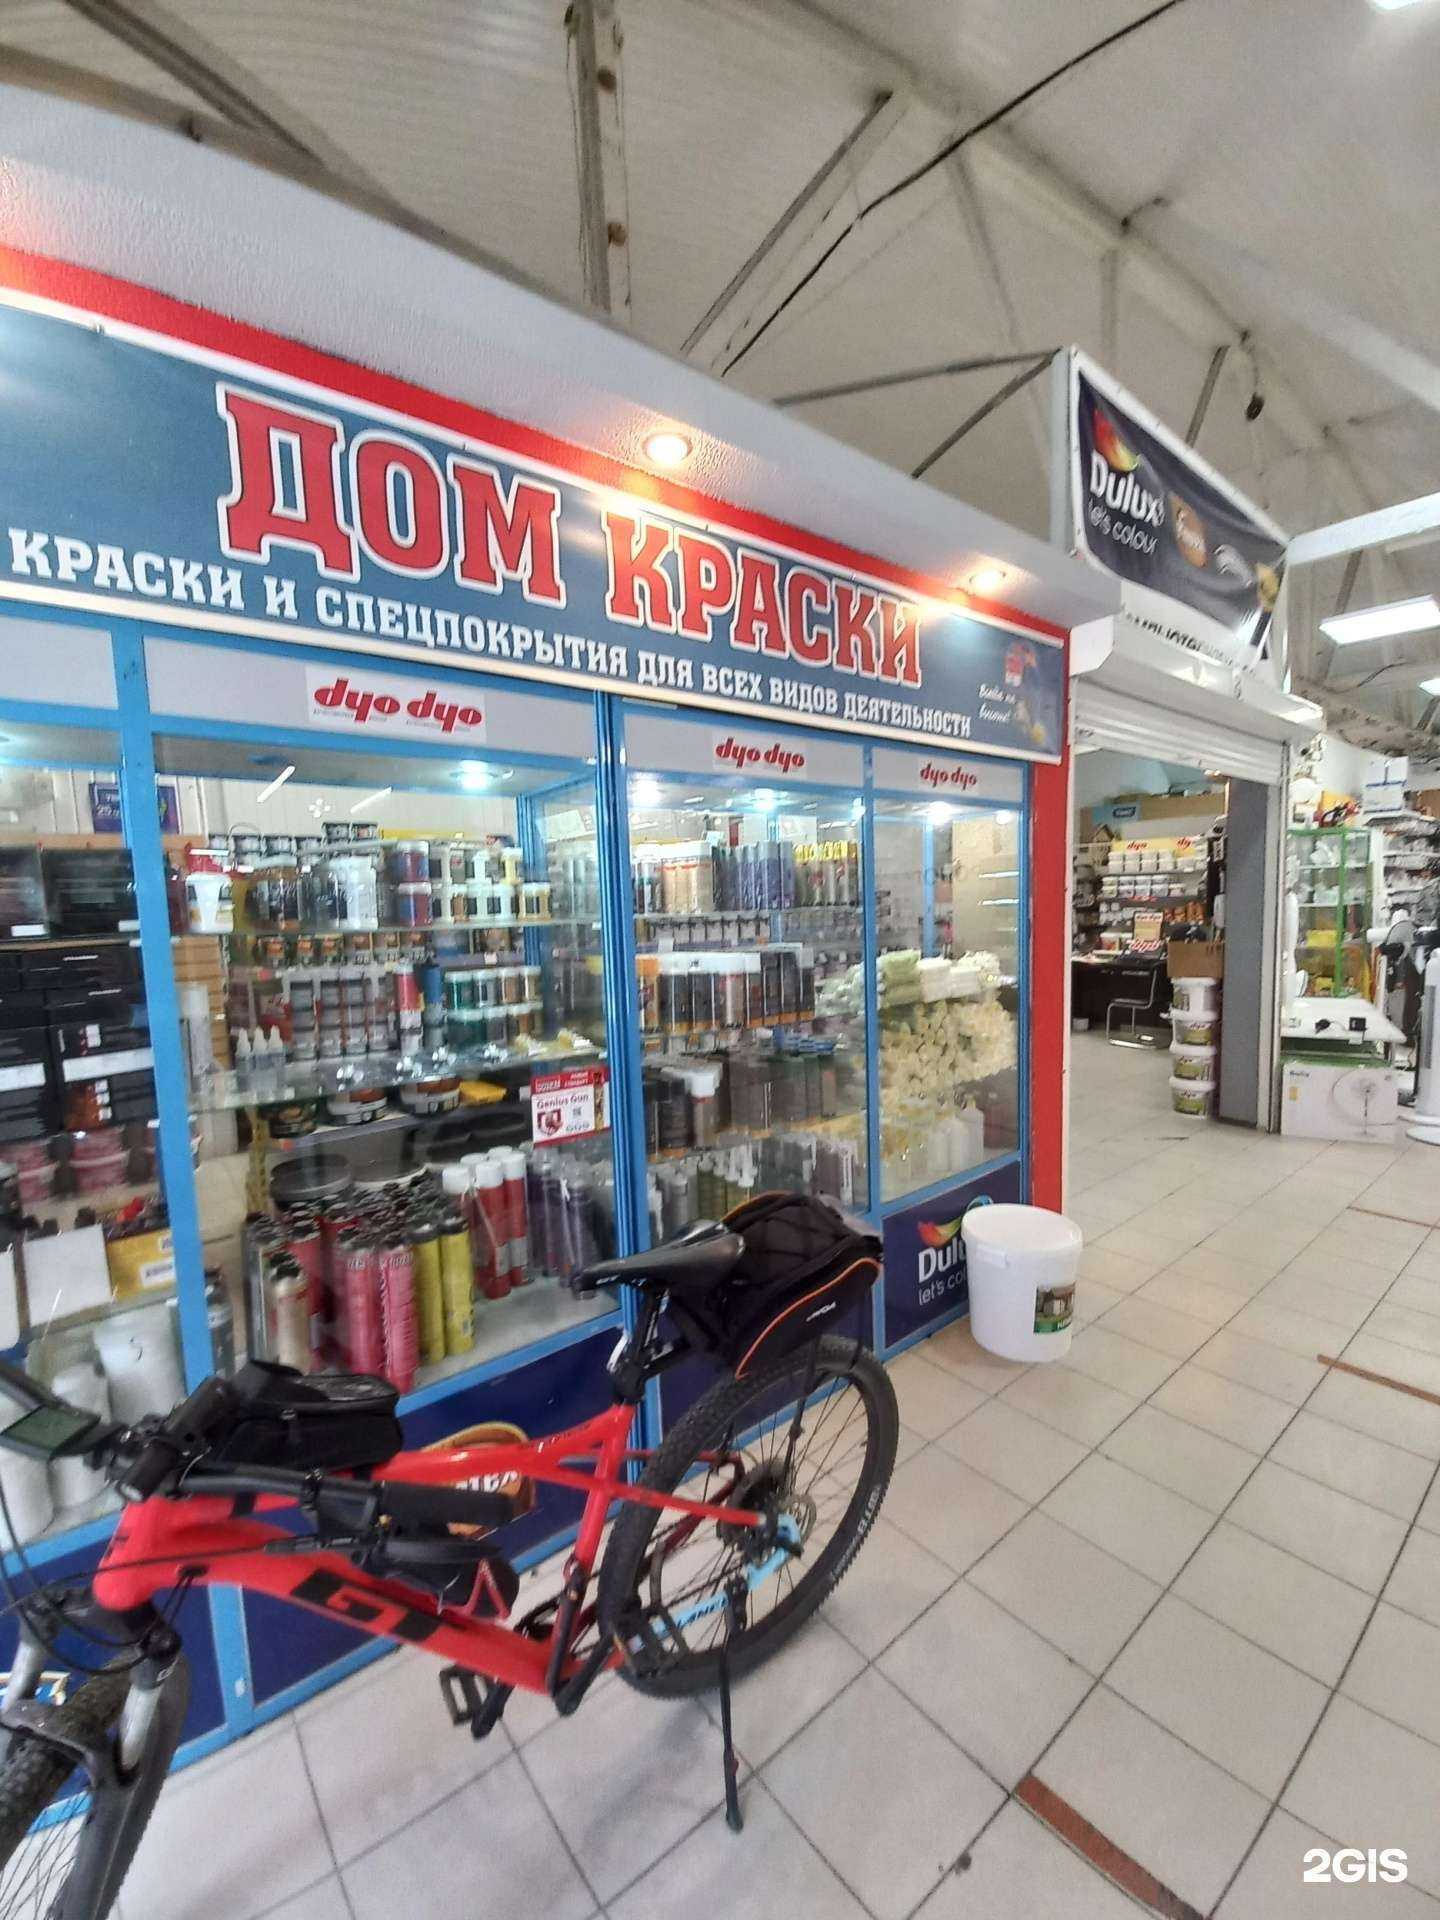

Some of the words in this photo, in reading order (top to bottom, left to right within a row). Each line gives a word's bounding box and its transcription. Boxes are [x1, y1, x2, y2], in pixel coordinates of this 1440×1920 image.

[1090, 450, 1166, 527] Dulux
[216, 381, 567, 609] ДОМ
[601, 506, 922, 690] КРАСКИ
[1112, 520, 1159, 555] colour
[8, 526, 245, 610] КРАСКИ
[263, 574, 299, 620] И
[315, 586, 628, 677] СПЕЦПОКРЫТИЯ
[638, 650, 693, 688] ДЛЯ
[702, 663, 763, 702] ВСЕХ
[769, 678, 838, 714] ВИДОВ
[843, 691, 972, 738] ДЕЯТЕЛЬНОСТИ
[314, 678, 400, 722] dyo
[407, 691, 482, 732] dyo
[715, 738, 760, 768] dyo
[764, 743, 805, 773] dyo
[920, 763, 948, 787] dyo
[950, 769, 977, 790] dyo
[918, 1237, 966, 1284] Dulu
[918, 1280, 945, 1306] let's
